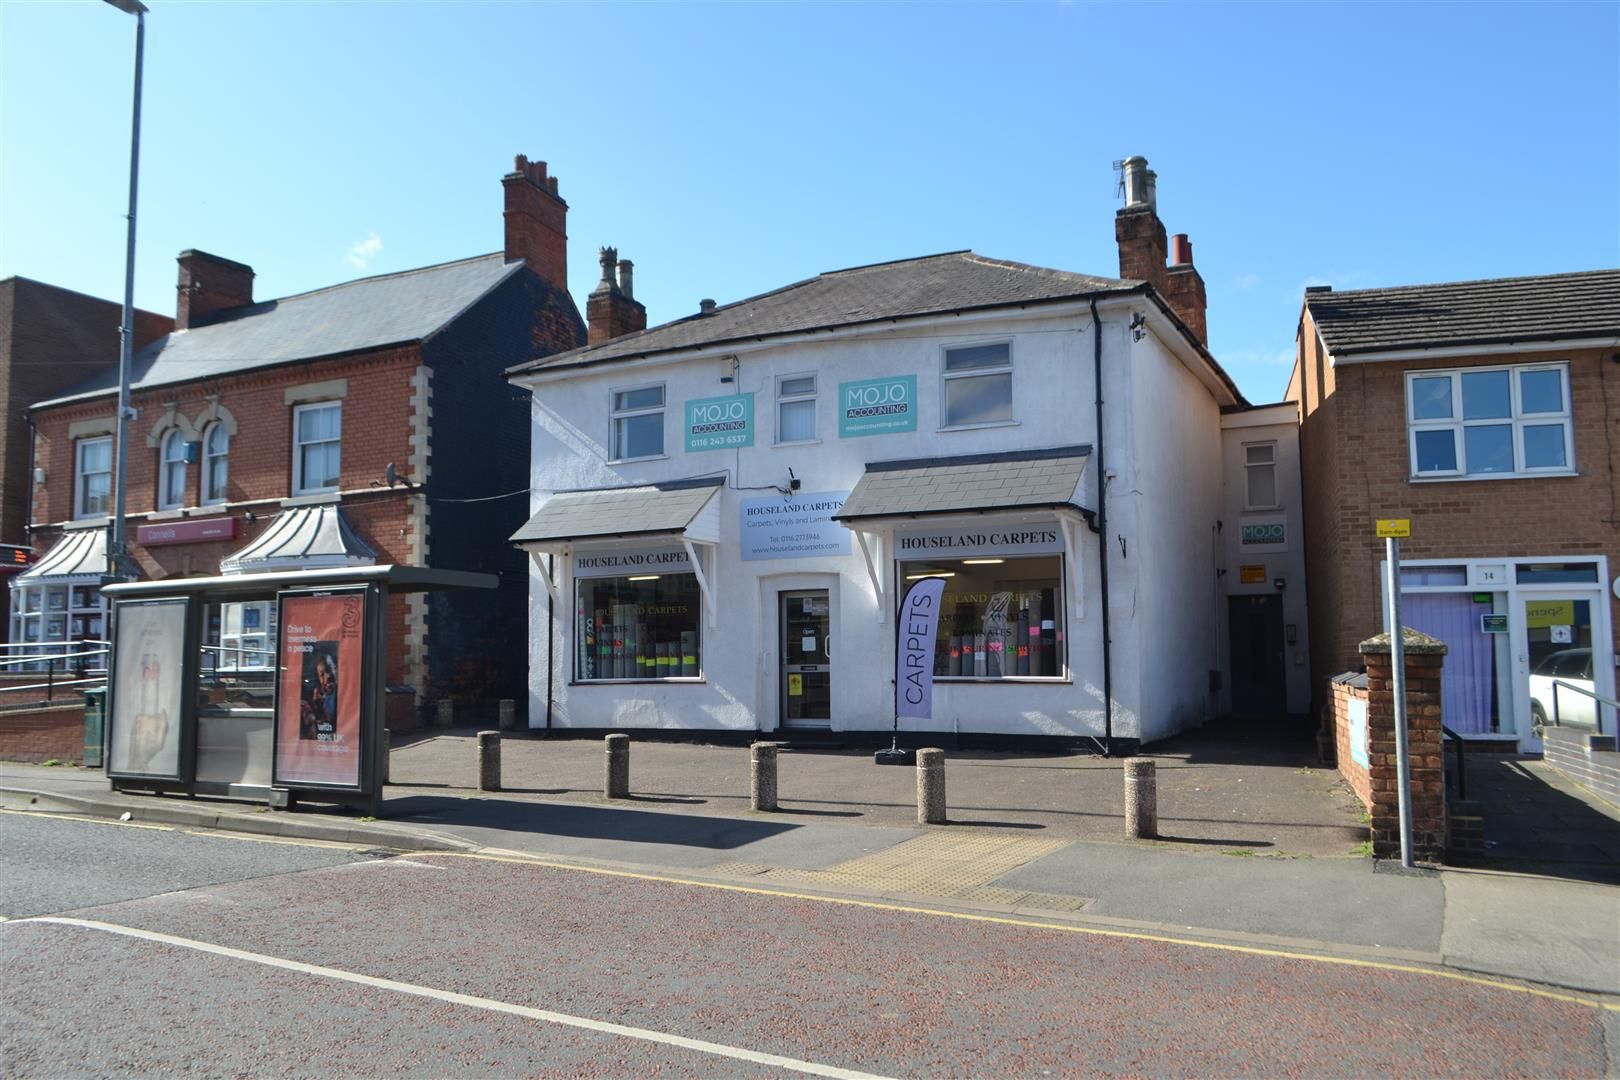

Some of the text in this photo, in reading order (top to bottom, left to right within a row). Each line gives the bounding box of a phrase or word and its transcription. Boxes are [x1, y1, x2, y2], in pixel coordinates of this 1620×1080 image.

[848, 384, 905, 407] MOJO
[693, 402, 744, 423] MOJO
[848, 404, 906, 417] ACCOUNTING
[693, 421, 745, 433] ACCOUNTING
[691, 439, 708, 447] 0116
[710, 436, 725, 446] 243
[747, 500, 844, 516] HOUSELAND CARPETS
[775, 517, 795, 527] Vinyls
[1243, 525, 1283, 538] MOJO
[902, 530, 1057, 549] HOUSELAND CARPETS
[752, 542, 840, 554] www.houselandcarpets.com
[579, 550, 690, 569] HOUSELAND CARPET
[1484, 572, 1494, 580] 14
[905, 594, 932, 705] CARPETS
